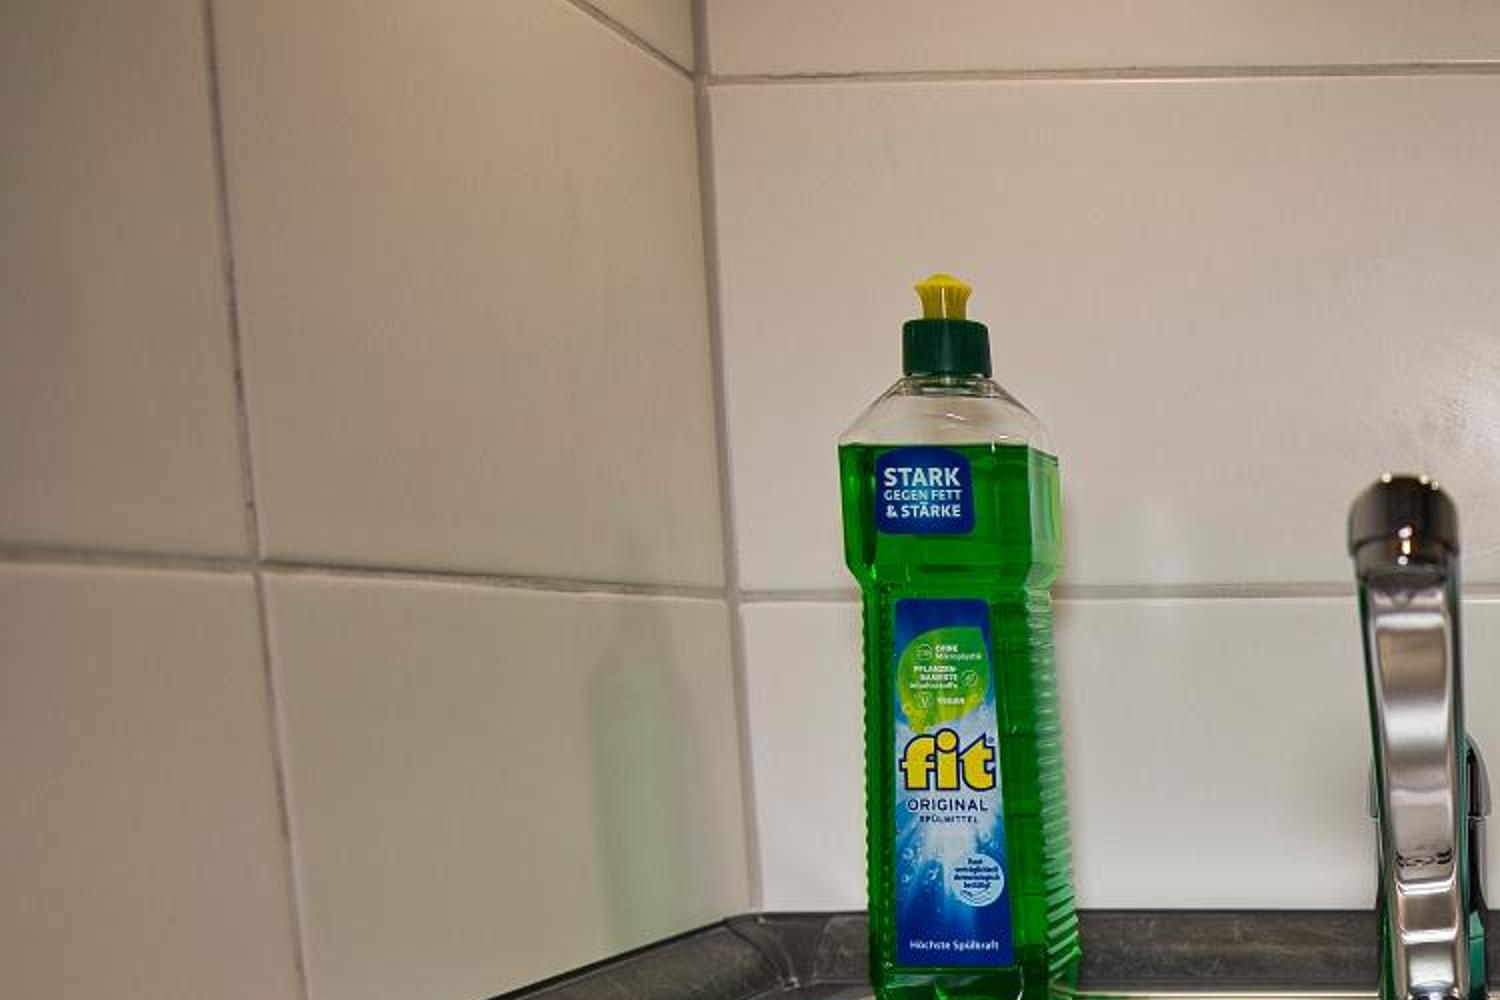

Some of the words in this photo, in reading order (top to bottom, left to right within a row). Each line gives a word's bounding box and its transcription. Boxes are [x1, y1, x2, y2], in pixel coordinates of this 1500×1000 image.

[883, 467, 961, 487] STARK
[883, 489, 929, 501] GEGEN
[931, 489, 963, 501] FETT
[886, 504, 898, 518] &
[901, 501, 961, 518] STÄRKE
[898, 727, 997, 792] fit
[907, 799, 989, 811] ORIGINAL
